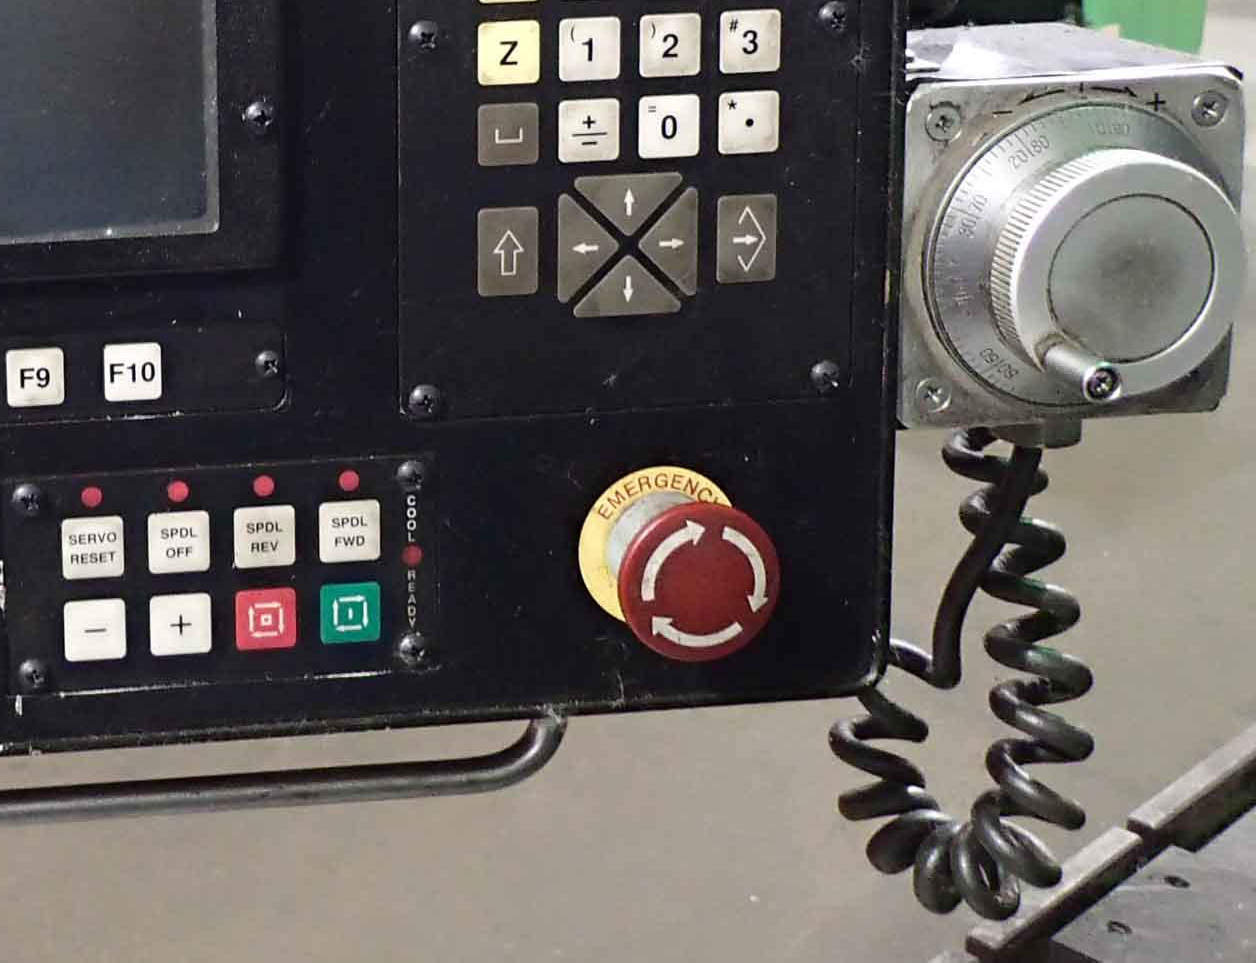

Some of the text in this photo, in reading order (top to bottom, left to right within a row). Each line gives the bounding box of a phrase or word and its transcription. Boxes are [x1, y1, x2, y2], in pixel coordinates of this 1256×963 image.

[582, 37, 594, 63] 1
[662, 33, 679, 59] 2
[741, 30, 759, 55] 3
[499, 41, 518, 67] Z
[19, 367, 51, 390] F9
[109, 361, 156, 384] F10
[246, 521, 283, 536] SPDL
[331, 516, 368, 530] SPDL
[68, 532, 118, 547] SERVO
[160, 527, 197, 540] SPDL
[250, 540, 279, 554] REV
[334, 534, 366, 549] FWD
[70, 551, 116, 566] RESET
[165, 546, 193, 559] OFF
